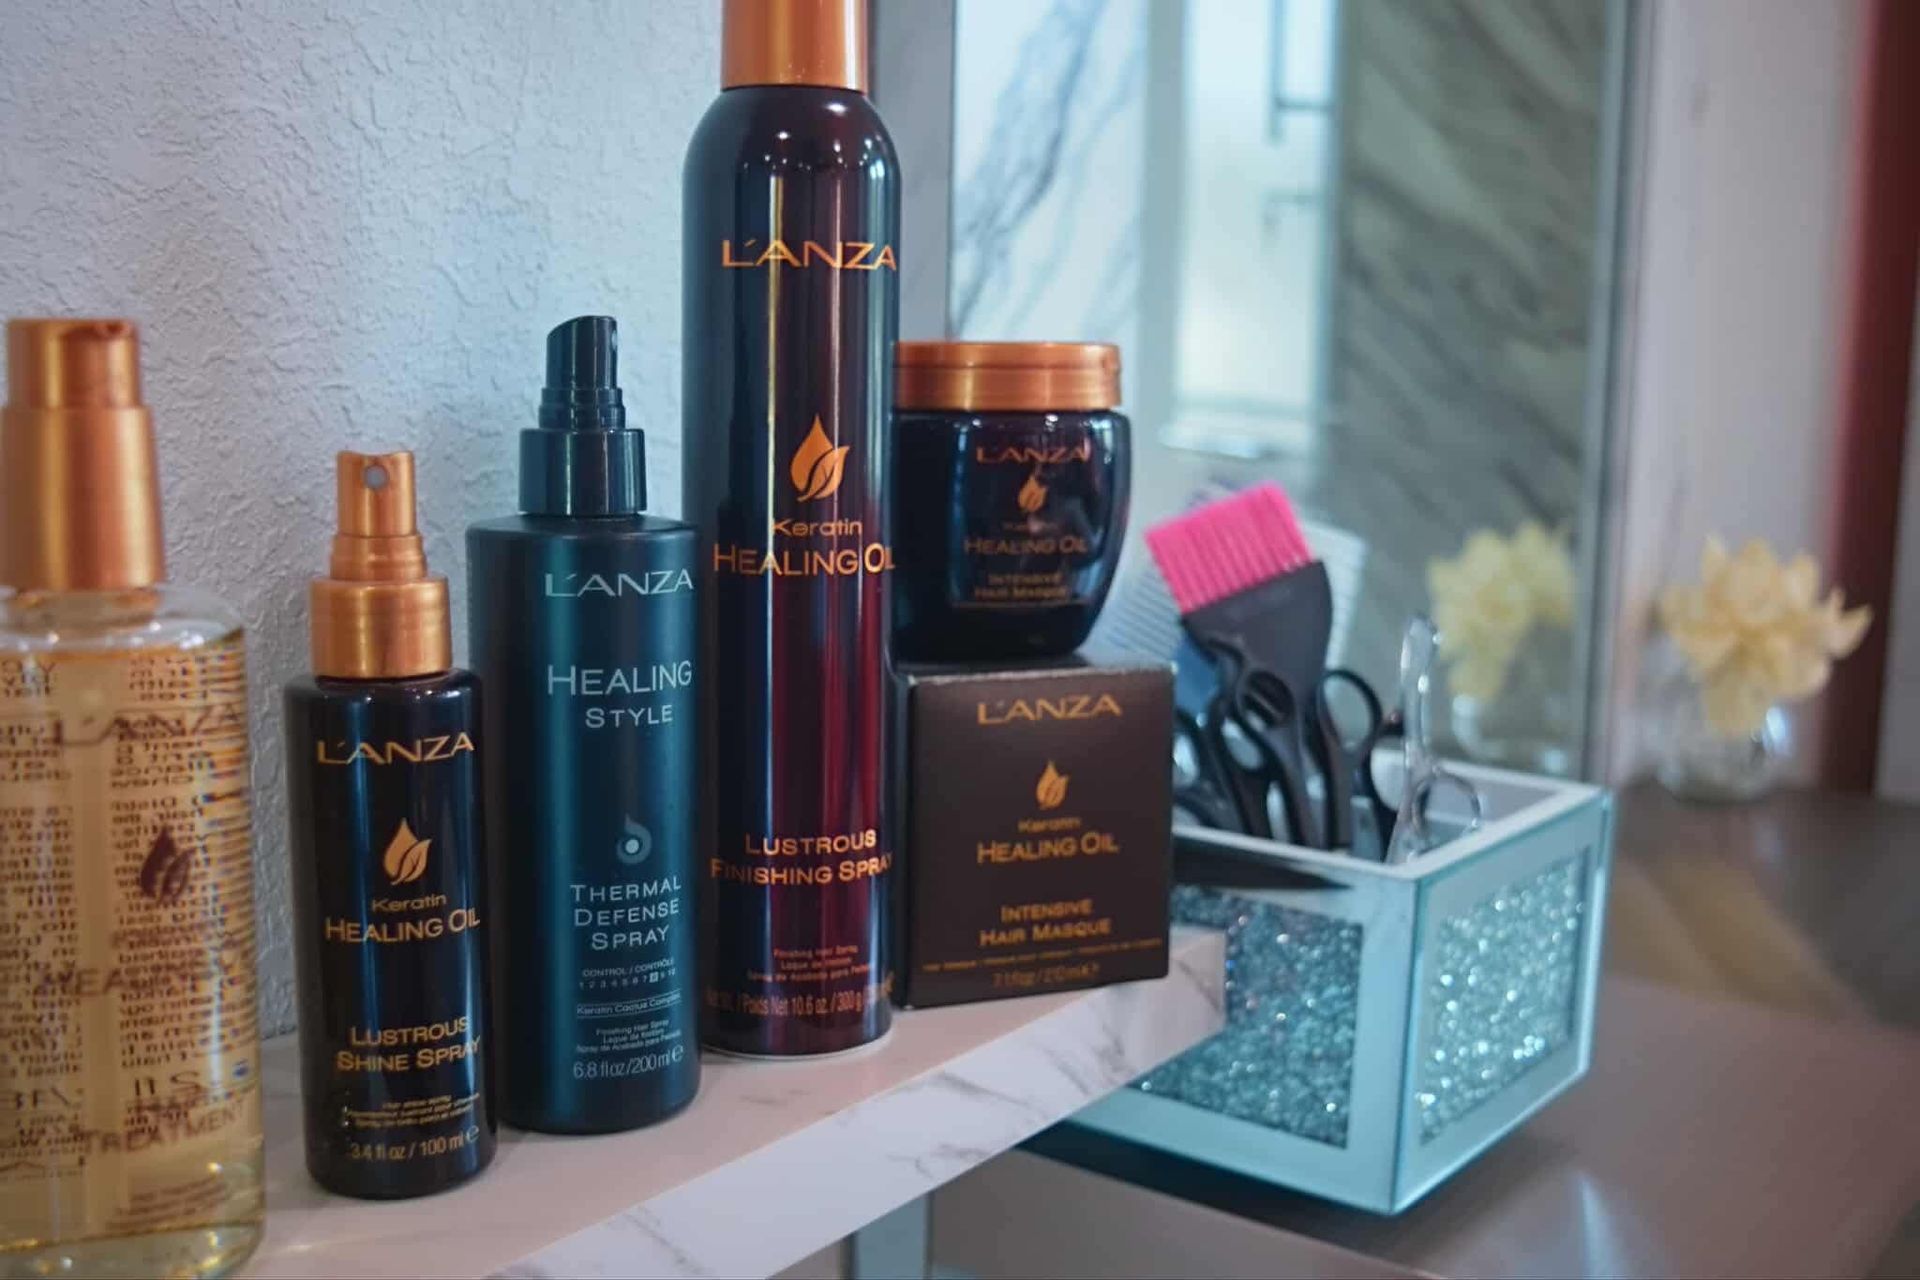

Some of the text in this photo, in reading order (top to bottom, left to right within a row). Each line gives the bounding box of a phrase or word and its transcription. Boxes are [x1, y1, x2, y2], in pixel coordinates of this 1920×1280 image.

[722, 237, 897, 271] L'ANZA
[772, 517, 863, 538] Keratin
[712, 542, 859, 577] HEALING
[544, 567, 694, 597] L'ANZA
[547, 659, 692, 696] HEALING
[584, 704, 673, 729] STYLE
[976, 693, 1123, 725] L'ANZA
[317, 731, 475, 766] L'ANZA
[744, 828, 878, 857] LUSTROUS
[976, 831, 1119, 865] HEALING OIL
[709, 857, 834, 886] FINISHING
[371, 892, 448, 913] Keratin
[570, 875, 681, 903] THERMAL
[324, 906, 481, 943] HEALING OIL
[573, 898, 680, 927] DEFENSE
[1000, 899, 1094, 923] INTENSIVE
[591, 925, 670, 951] SPRAY
[978, 917, 1113, 947] HAIR MASQUE
[351, 1015, 471, 1047] LUSTROUS
[335, 1035, 481, 1073] SHINE SPRAY
[573, 1060, 598, 1079] 6.8
[420, 1136, 447, 1157] 100
